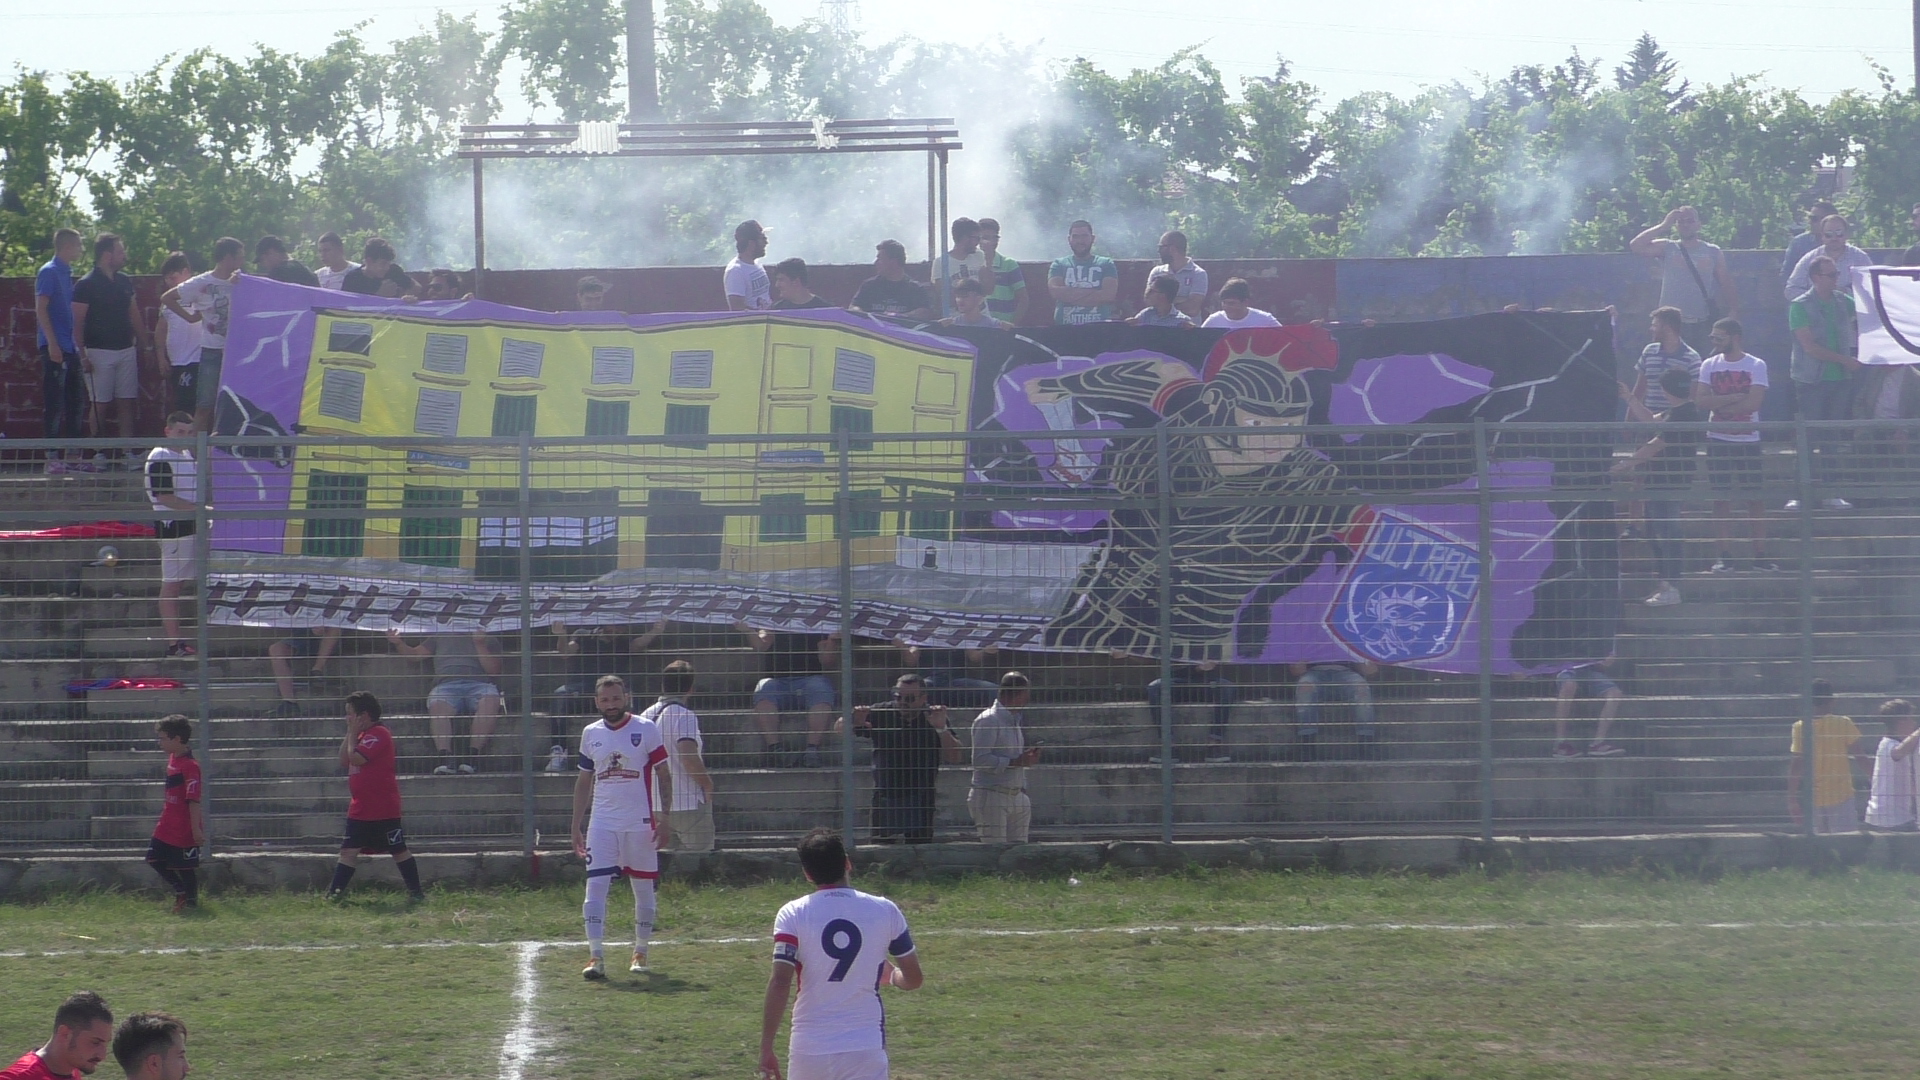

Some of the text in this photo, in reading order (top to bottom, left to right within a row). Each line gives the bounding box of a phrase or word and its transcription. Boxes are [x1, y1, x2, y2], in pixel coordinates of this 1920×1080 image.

[1065, 265, 1102, 287] ALC
[1365, 519, 1481, 601] ULTRAS
[821, 918, 863, 982] 9
